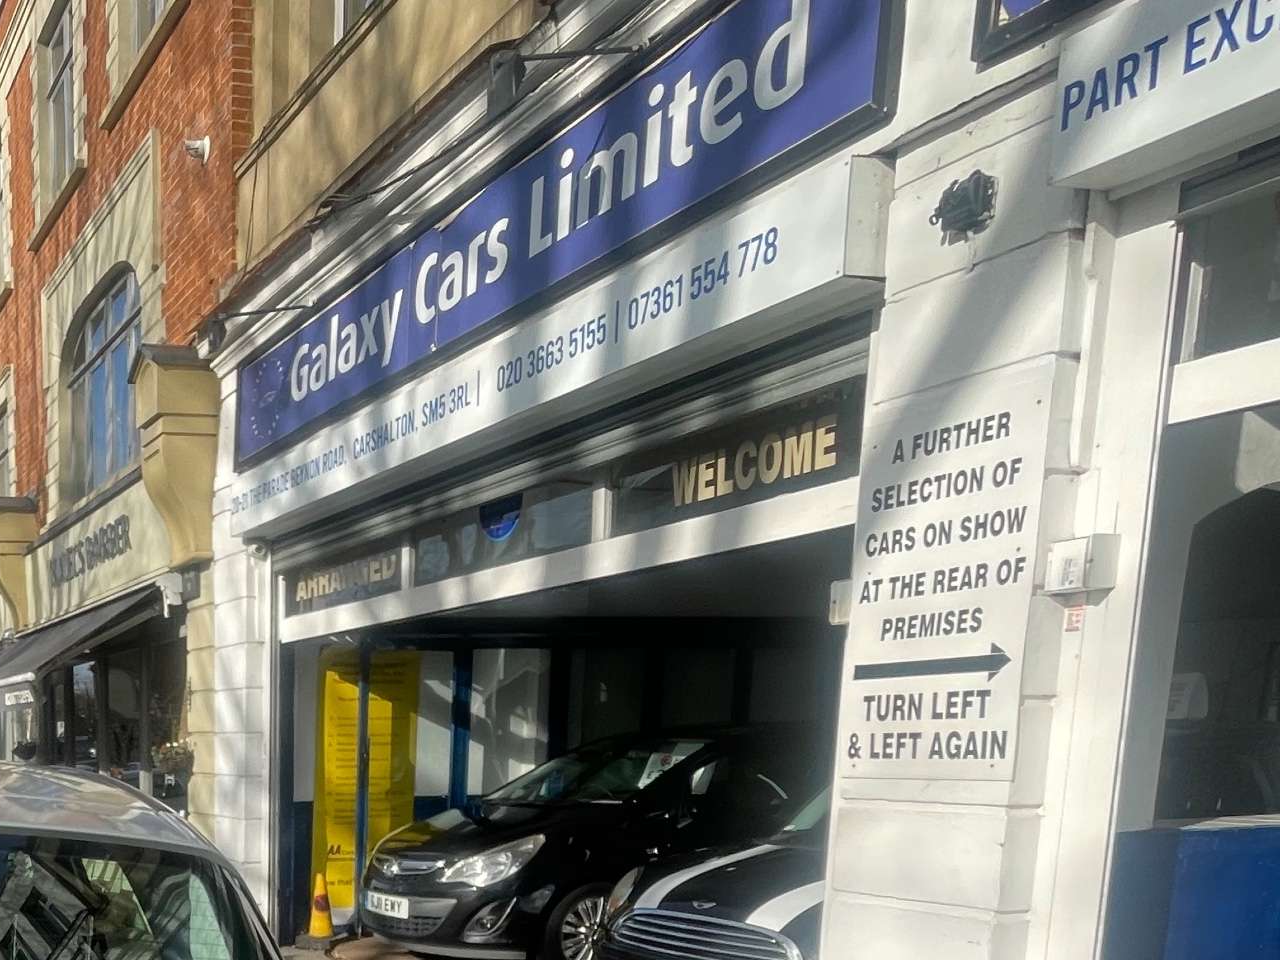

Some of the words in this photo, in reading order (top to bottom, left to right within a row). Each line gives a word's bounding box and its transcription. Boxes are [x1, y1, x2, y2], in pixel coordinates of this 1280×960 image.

[1060, 35, 1168, 131] PART
[291, 289, 403, 401] Galaxy
[415, 218, 509, 324] Cars
[529, 0, 809, 258] Limited
[422, 394, 446, 427] SM5
[449, 382, 470, 413] 3RL
[497, 356, 521, 392] 020
[527, 336, 563, 378] 3663
[569, 314, 606, 358] 5155
[628, 274, 683, 330] 07361
[690, 251, 730, 300] 554
[738, 226, 778, 278] 778
[672, 415, 838, 507] WELCOME
[892, 440, 905, 464] A
[911, 411, 1010, 460] FURTHER
[871, 466, 984, 513] SELECTION
[993, 458, 1022, 488] OF
[866, 527, 916, 558] CARS
[924, 520, 952, 547] ON
[960, 506, 1027, 543] SHOW
[296, 554, 397, 602] ARRAED
[860, 579, 883, 605] AT
[888, 573, 926, 601] THE
[933, 563, 988, 593] REAR
[996, 557, 1026, 584] OF
[881, 607, 983, 642] PREMISES
[863, 693, 923, 721] TURN
[932, 690, 991, 720] LEFT
[848, 733, 862, 758] &
[870, 732, 922, 759] LEFT
[929, 730, 1008, 760] AGAIN
